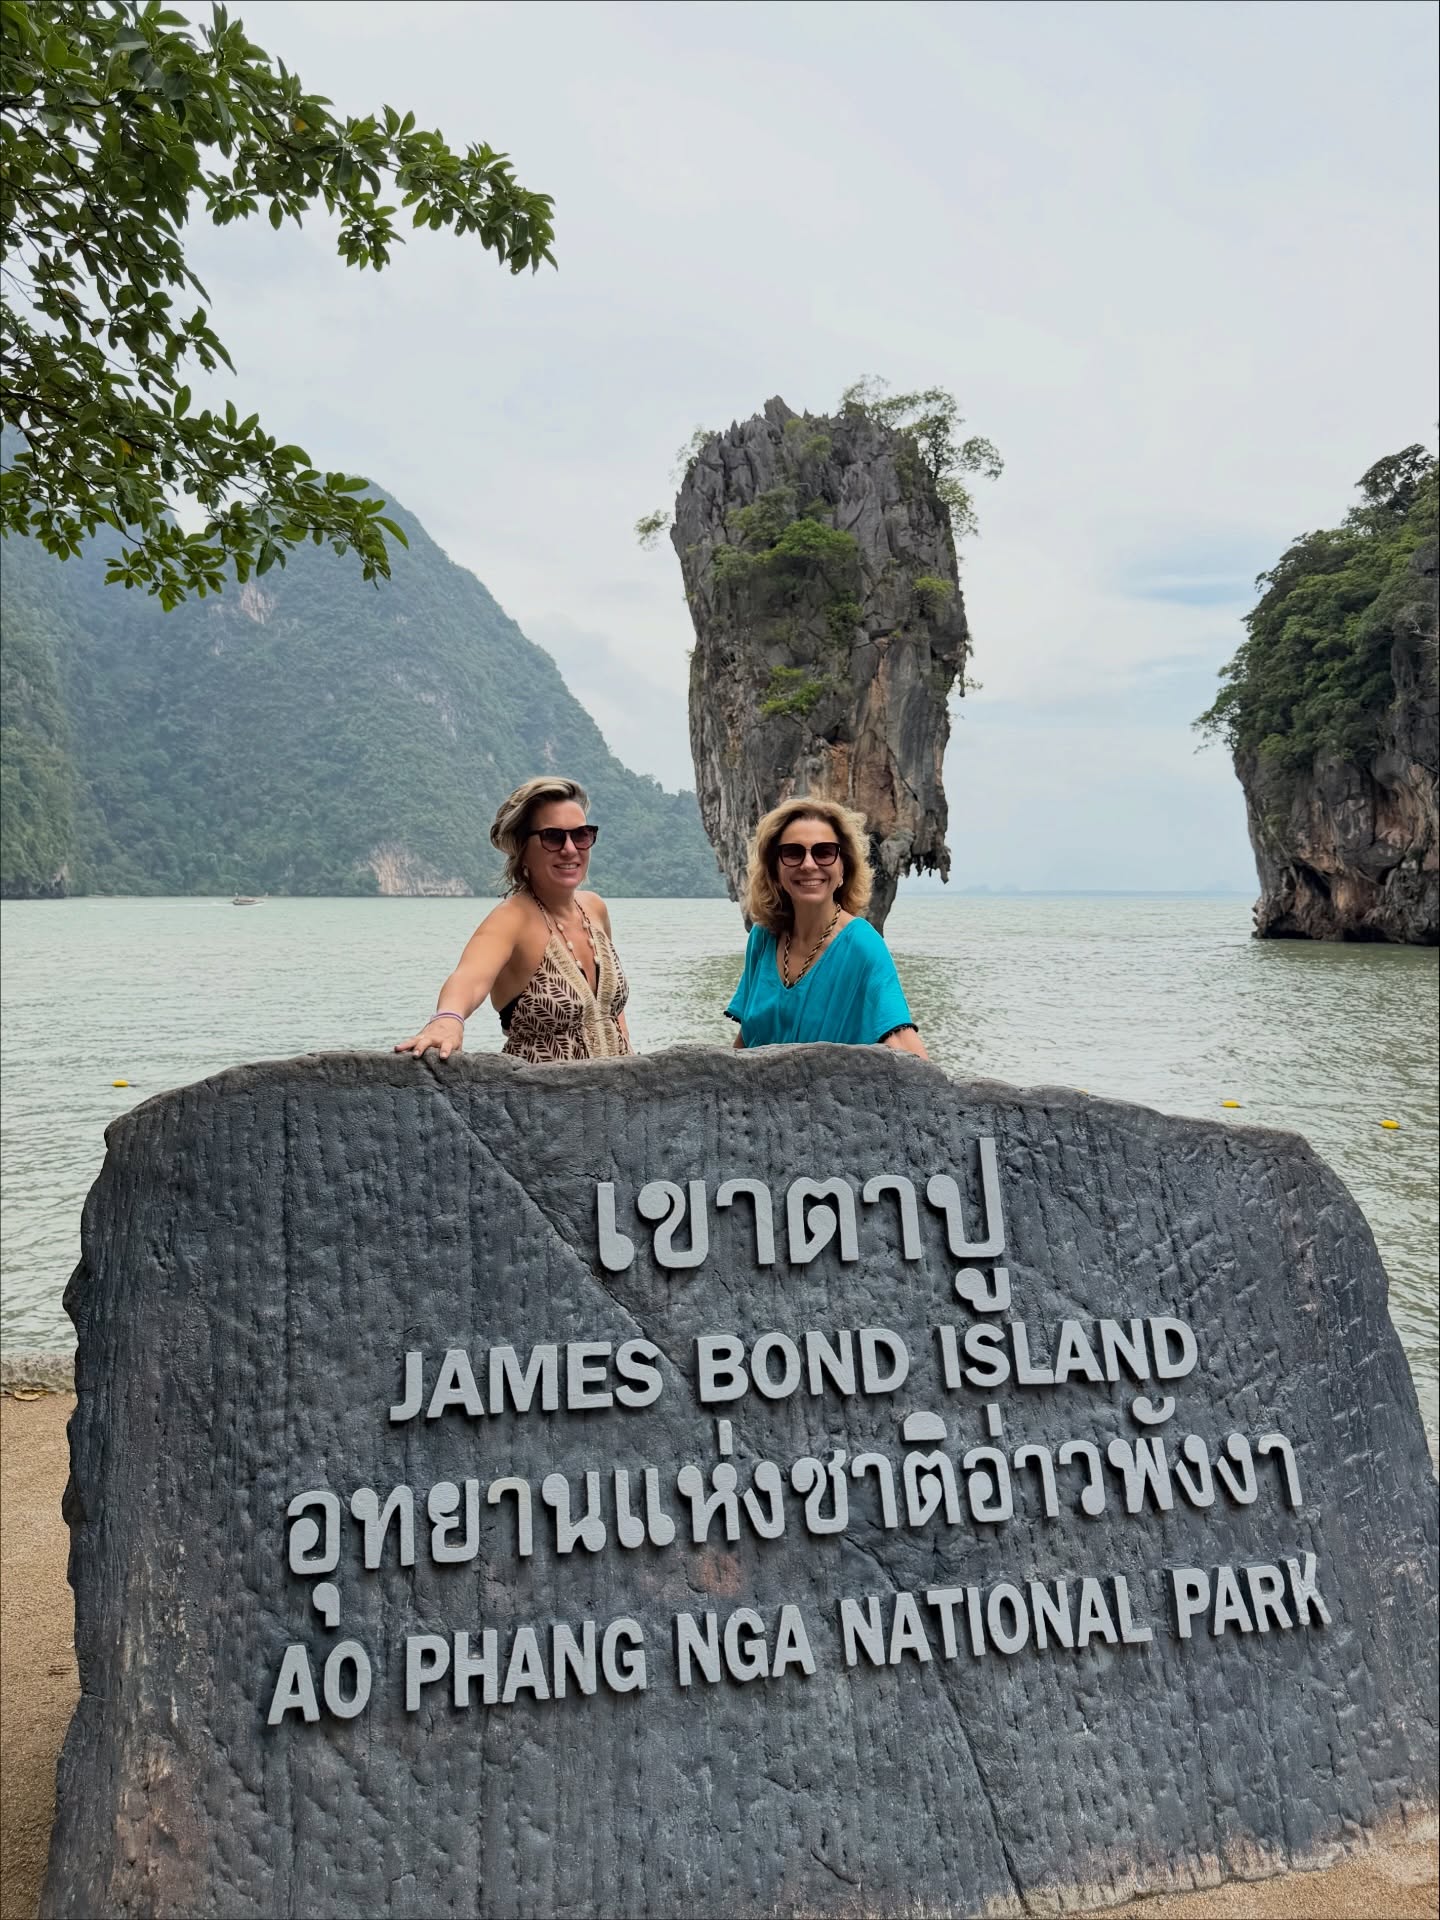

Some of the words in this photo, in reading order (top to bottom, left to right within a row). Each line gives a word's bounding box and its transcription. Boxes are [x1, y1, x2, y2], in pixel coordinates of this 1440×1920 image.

[597, 1137, 1011, 1312] เขาตาปู
[389, 1338, 664, 1421] JAMES
[694, 1328, 910, 1403] BOND
[937, 1317, 1199, 1388] ISLAND
[267, 1640, 373, 1725] AO
[405, 1616, 648, 1711] PHANG
[676, 1604, 816, 1686] NGA
[840, 1574, 1153, 1666] NATIONAL
[1168, 1552, 1332, 1639] PARK
